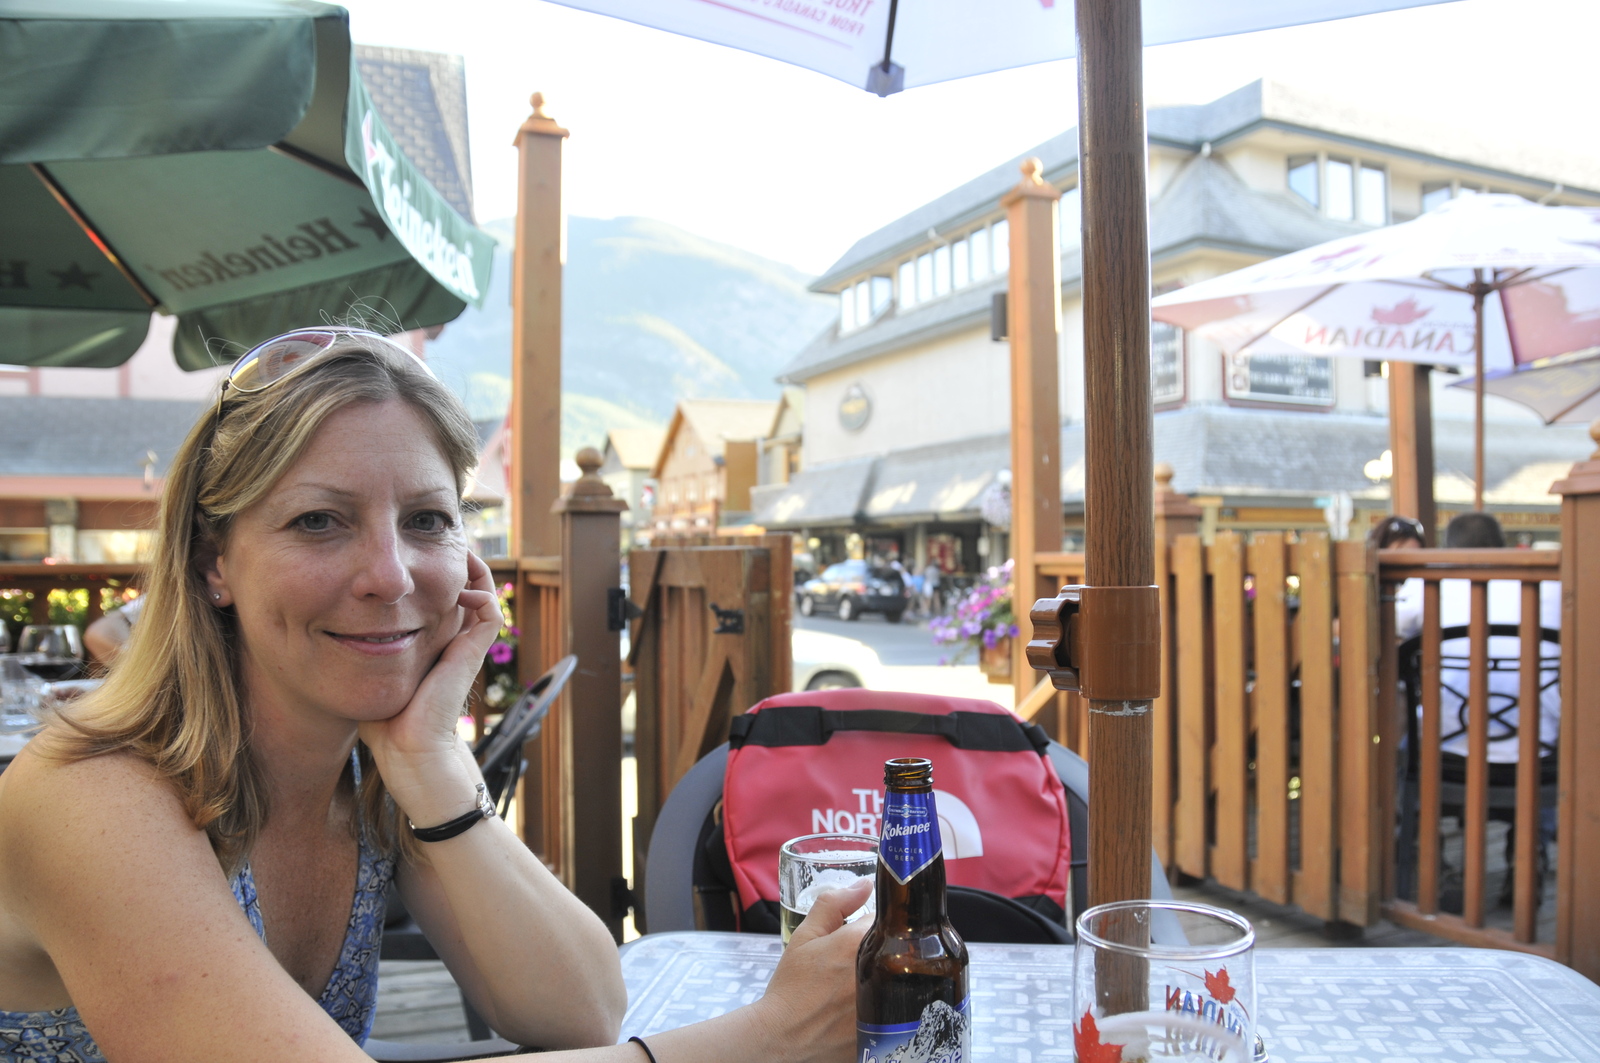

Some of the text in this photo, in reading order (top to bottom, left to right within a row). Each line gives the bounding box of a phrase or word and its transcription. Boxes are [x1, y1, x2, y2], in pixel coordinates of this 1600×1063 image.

[852, 788, 884, 814] TH
[811, 808, 882, 837] NOR
[881, 820, 931, 841] Kokanee
[888, 845, 923, 854] GLACIER
